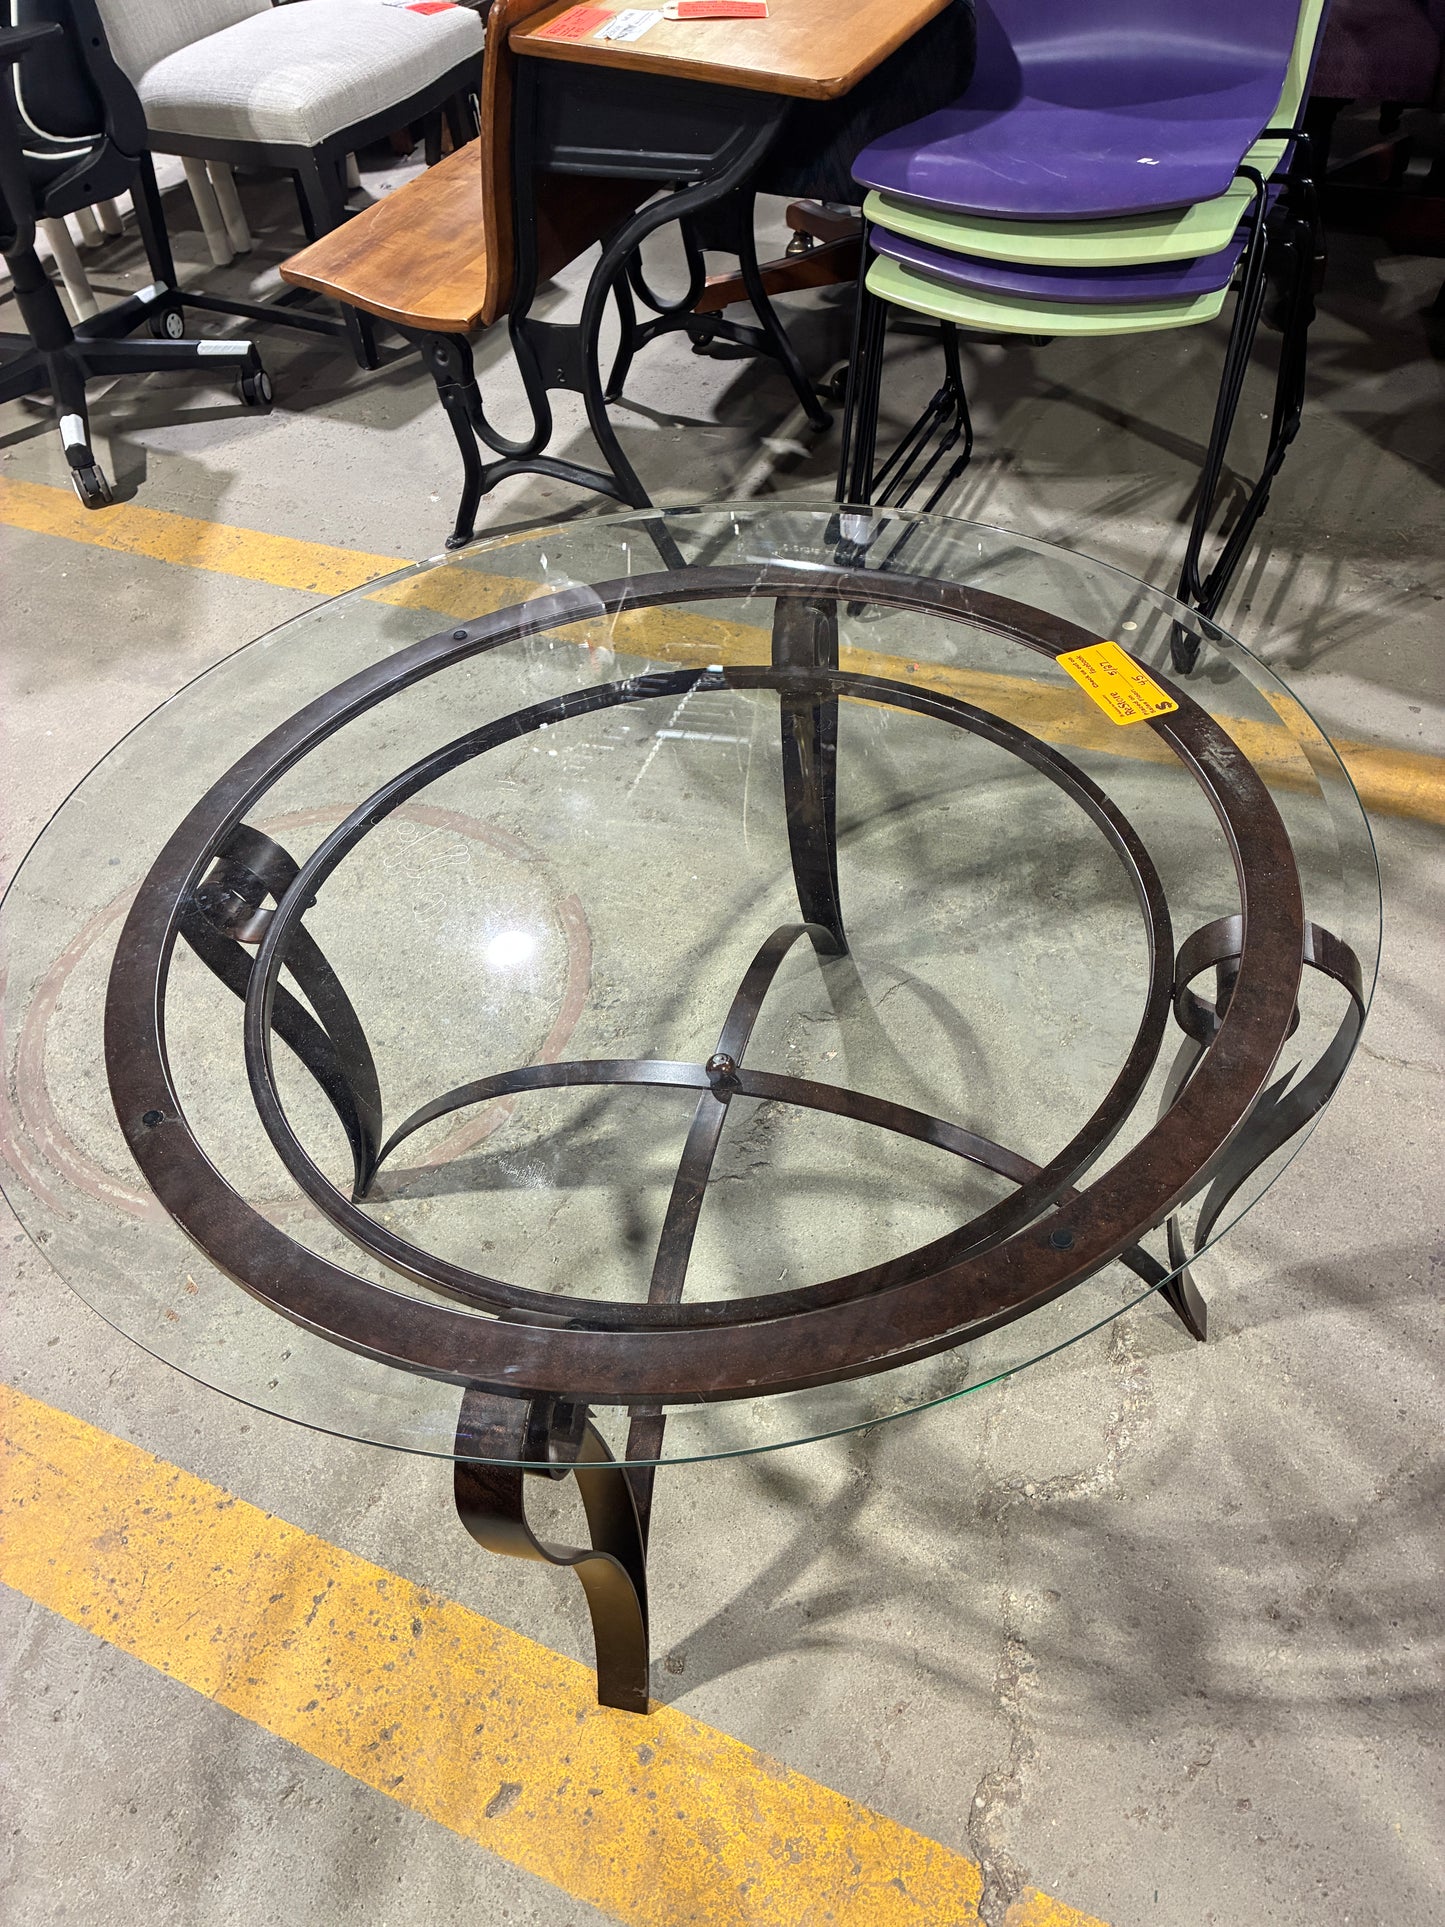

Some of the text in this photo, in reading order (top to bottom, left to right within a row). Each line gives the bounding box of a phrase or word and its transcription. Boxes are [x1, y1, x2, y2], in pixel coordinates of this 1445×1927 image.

[1131, 674, 1173, 711] $ 45
[1110, 691, 1136, 716] ReStore
[1132, 701, 1149, 715] Placed
[1142, 701, 1155, 713] Sales
